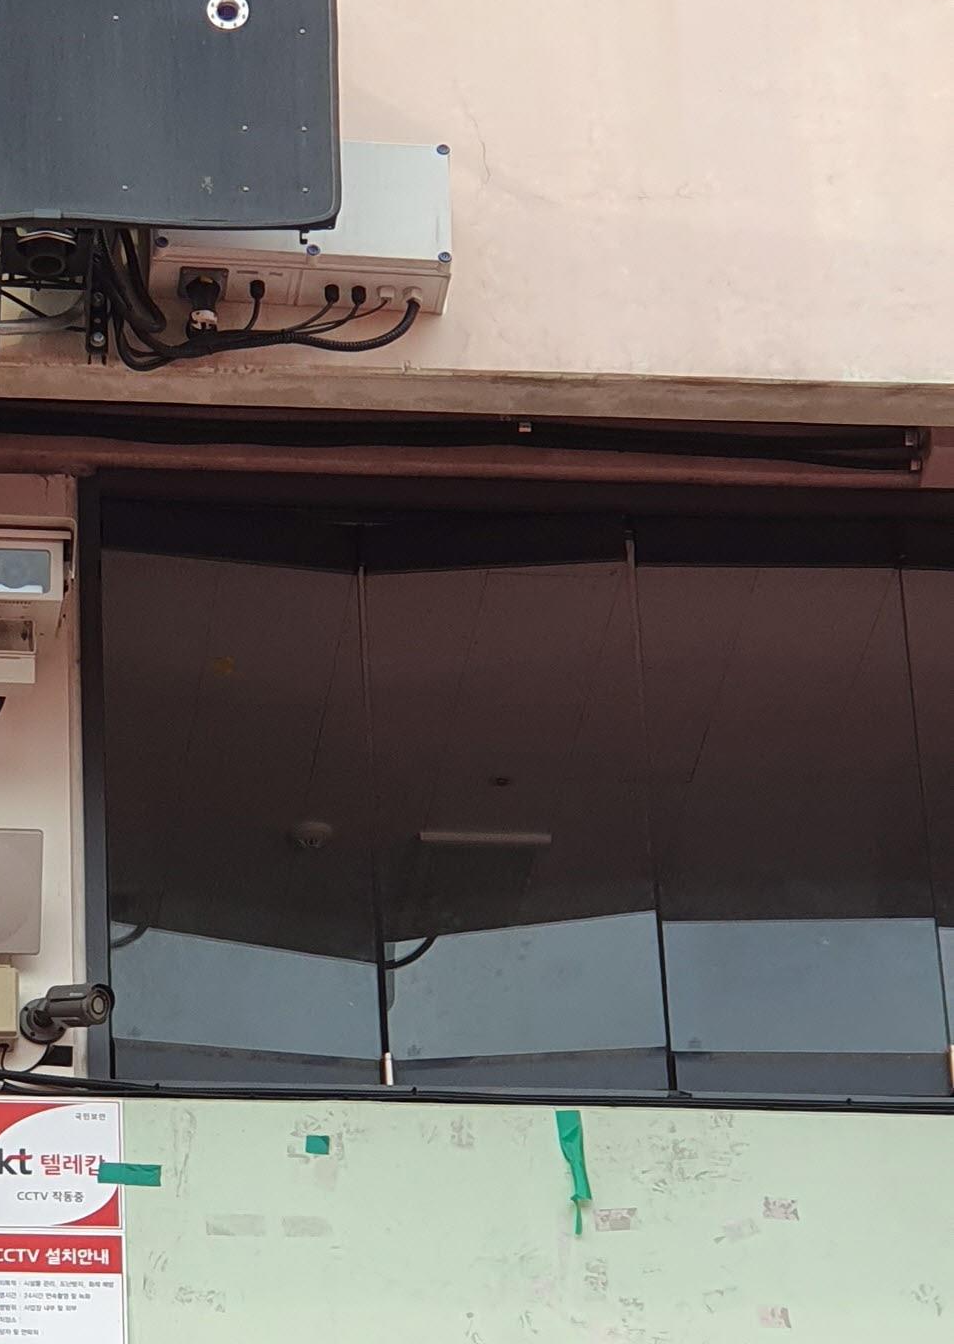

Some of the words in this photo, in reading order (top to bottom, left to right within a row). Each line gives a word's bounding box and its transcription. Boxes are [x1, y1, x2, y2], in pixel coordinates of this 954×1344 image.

[17, 1191, 48, 1201] CCTV
[52, 1191, 84, 1203] 작동중
[45, 1247, 110, 1265] 설치안내
